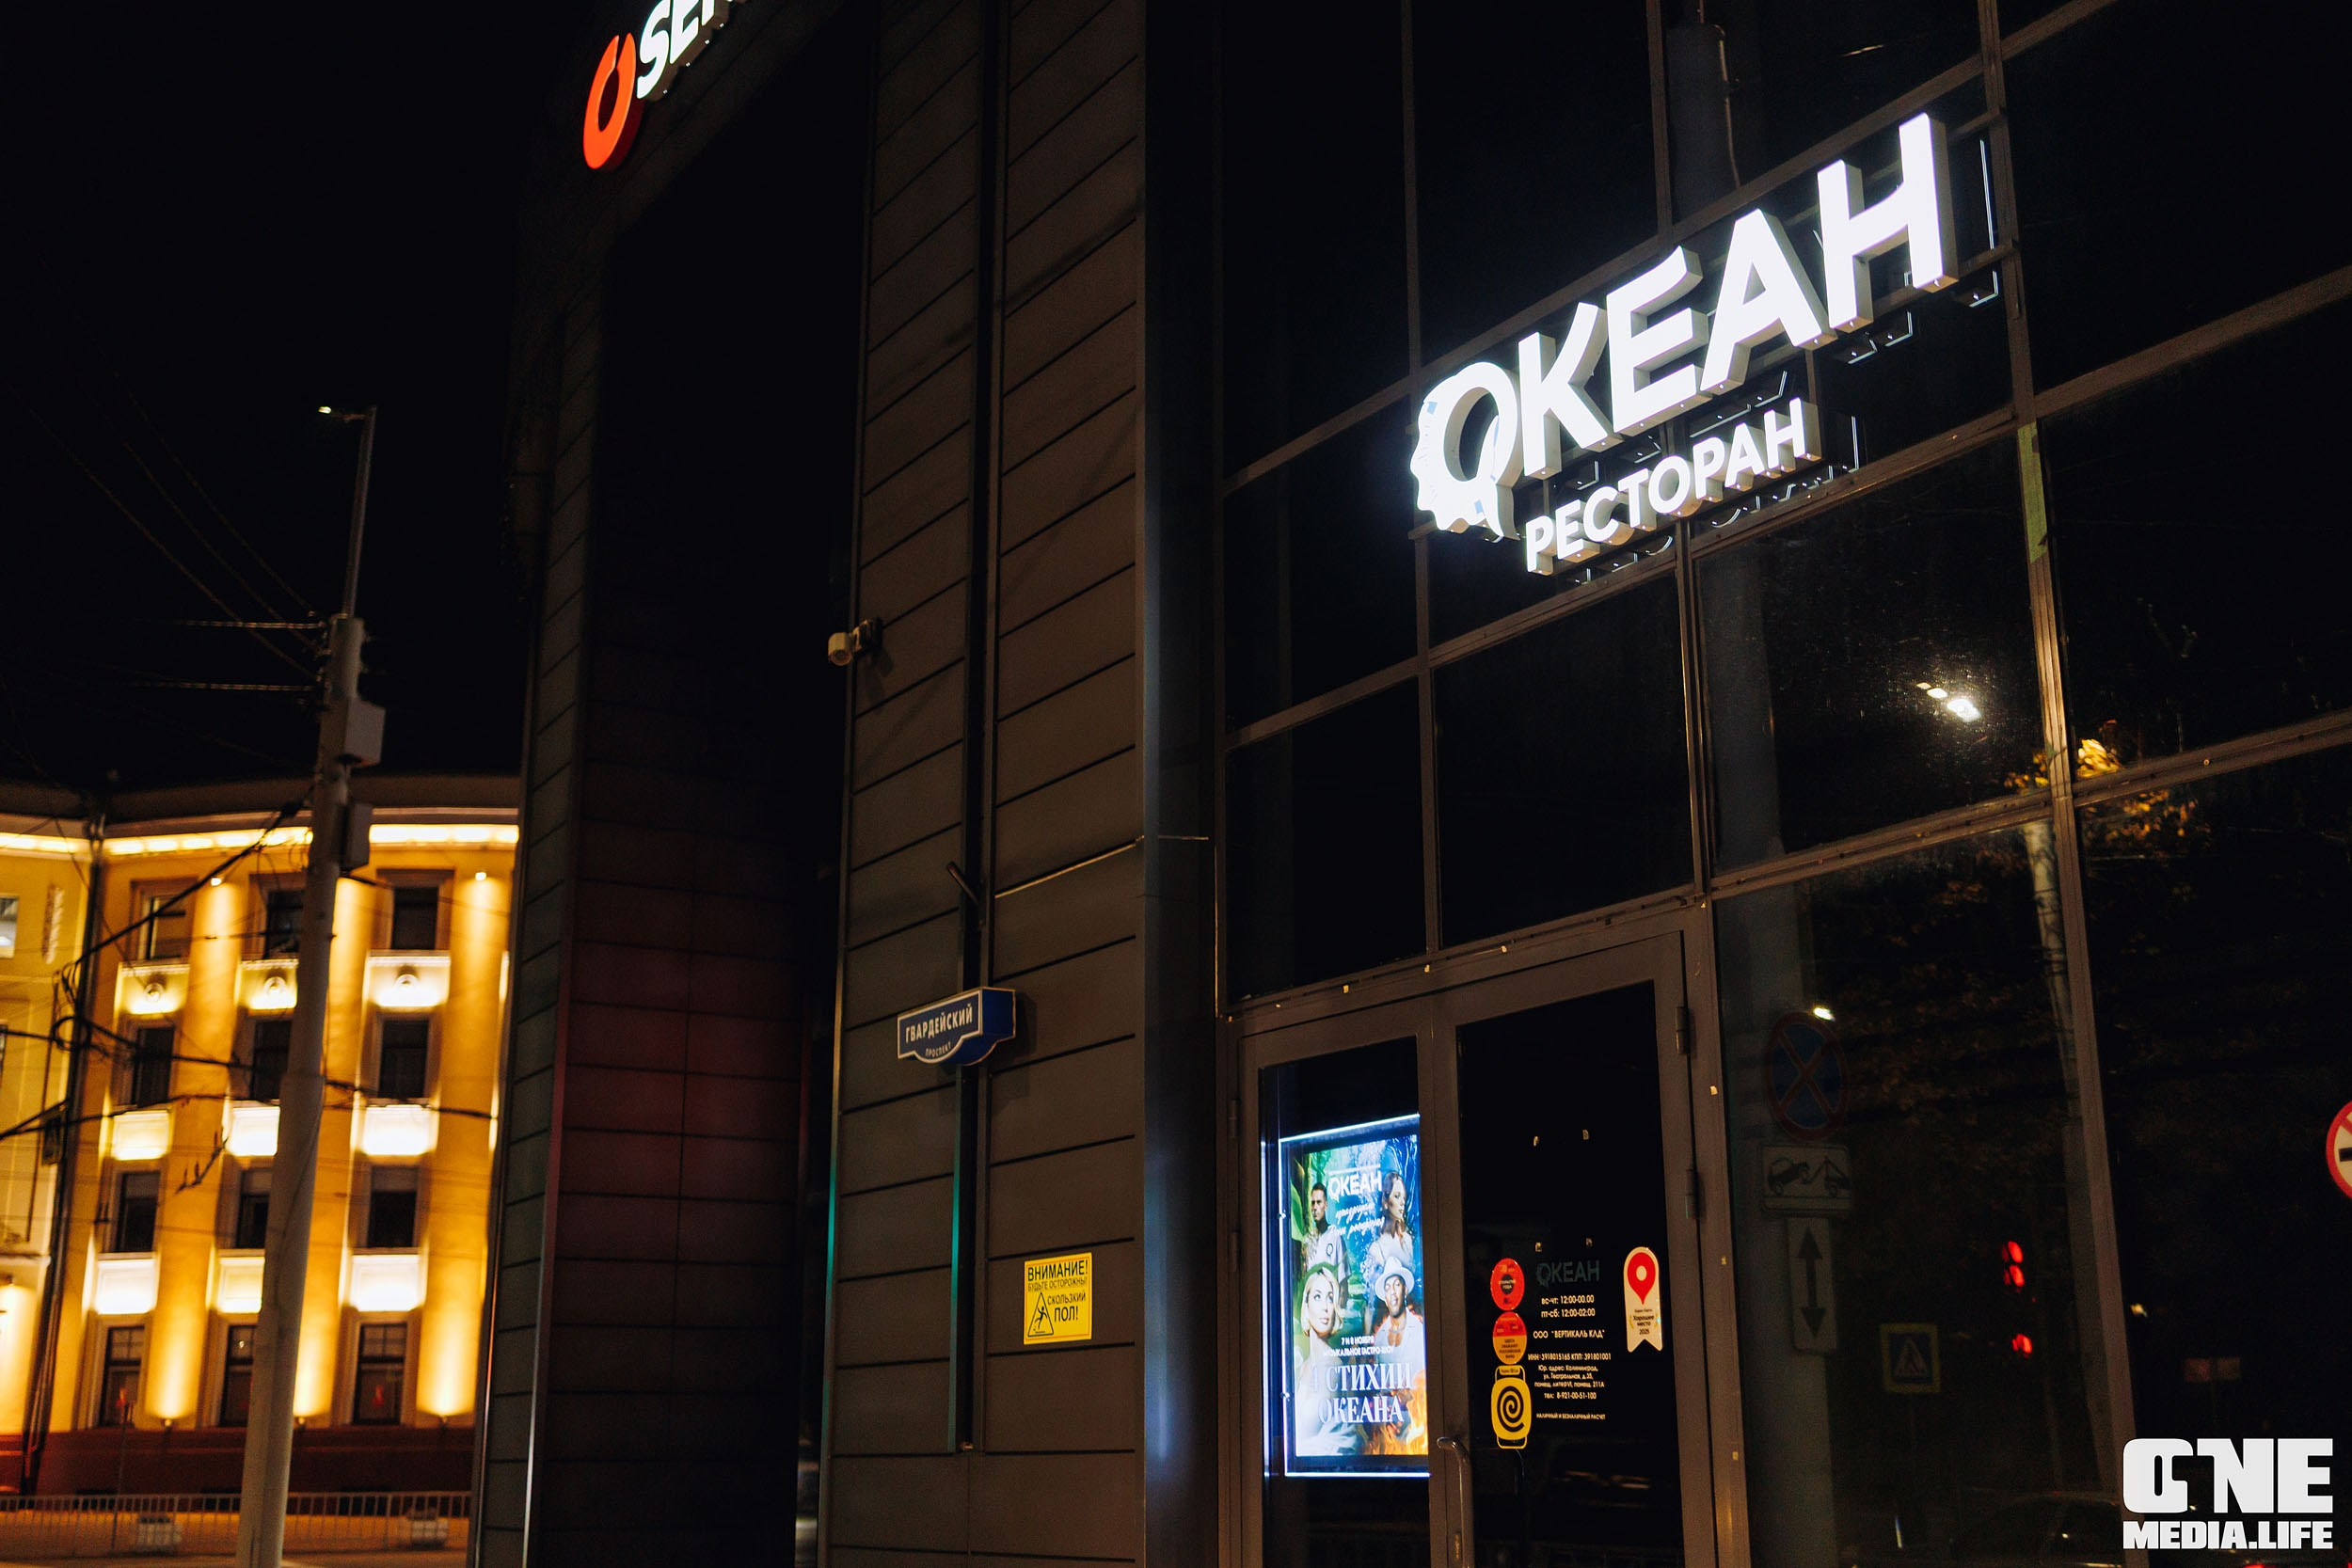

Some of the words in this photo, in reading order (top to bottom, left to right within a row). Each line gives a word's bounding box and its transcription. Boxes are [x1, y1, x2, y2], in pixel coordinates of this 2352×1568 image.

[1410, 112, 1952, 540] ОКЕАН
[1526, 398, 1816, 575] РЕСТОРАН
[905, 1003, 973, 1043] ГВАРДЕЙСКИЙ
[925, 1041, 952, 1057] ПРОСПЕКТ
[1327, 1170, 1382, 1203] ОКЕАН
[1027, 1259, 1088, 1281] ВНИМАНИЕ!
[1535, 1259, 1600, 1288] ОКЕАН
[1047, 1290, 1086, 1306] СКОЛЬЗКИЙ
[1054, 1306, 1078, 1323] ПОЛ!
[1561, 1307, 1596, 1318] 12:00-02:00
[1533, 1330, 1549, 1339] ООО
[1326, 1362, 1412, 1392] СТИХИИ
[1556, 1391, 1597, 1400] 8-921-00-51-100
[1318, 1394, 1405, 1424] ОКЕАНА
